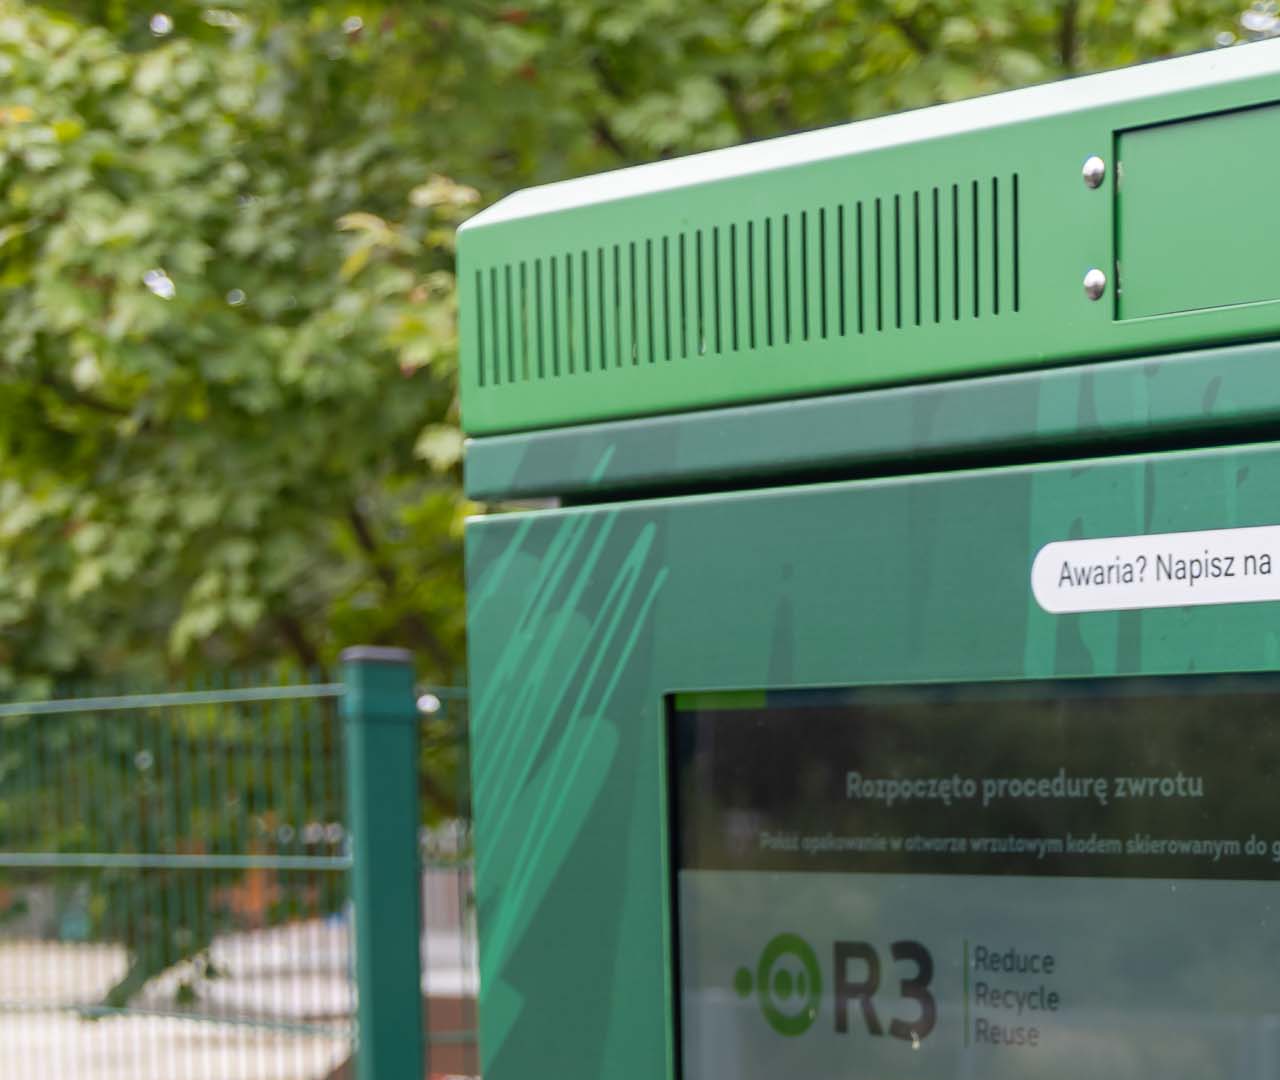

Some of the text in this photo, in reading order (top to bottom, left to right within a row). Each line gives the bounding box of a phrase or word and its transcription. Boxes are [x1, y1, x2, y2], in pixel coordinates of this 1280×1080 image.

[1058, 555, 1147, 588] Awaria?
[1156, 550, 1236, 583] Napisz
[1243, 554, 1272, 575] na
[846, 768, 1204, 806] Rozpoczęto procedurę zwrotu
[1066, 833, 1121, 854] kodem
[1126, 833, 1240, 860] skierowanym
[1245, 834, 1266, 856] do
[975, 946, 1055, 974] Reduce
[833, 940, 937, 1041] R3
[975, 983, 1060, 1014] Recycle
[975, 1018, 1040, 1047] Reuse
